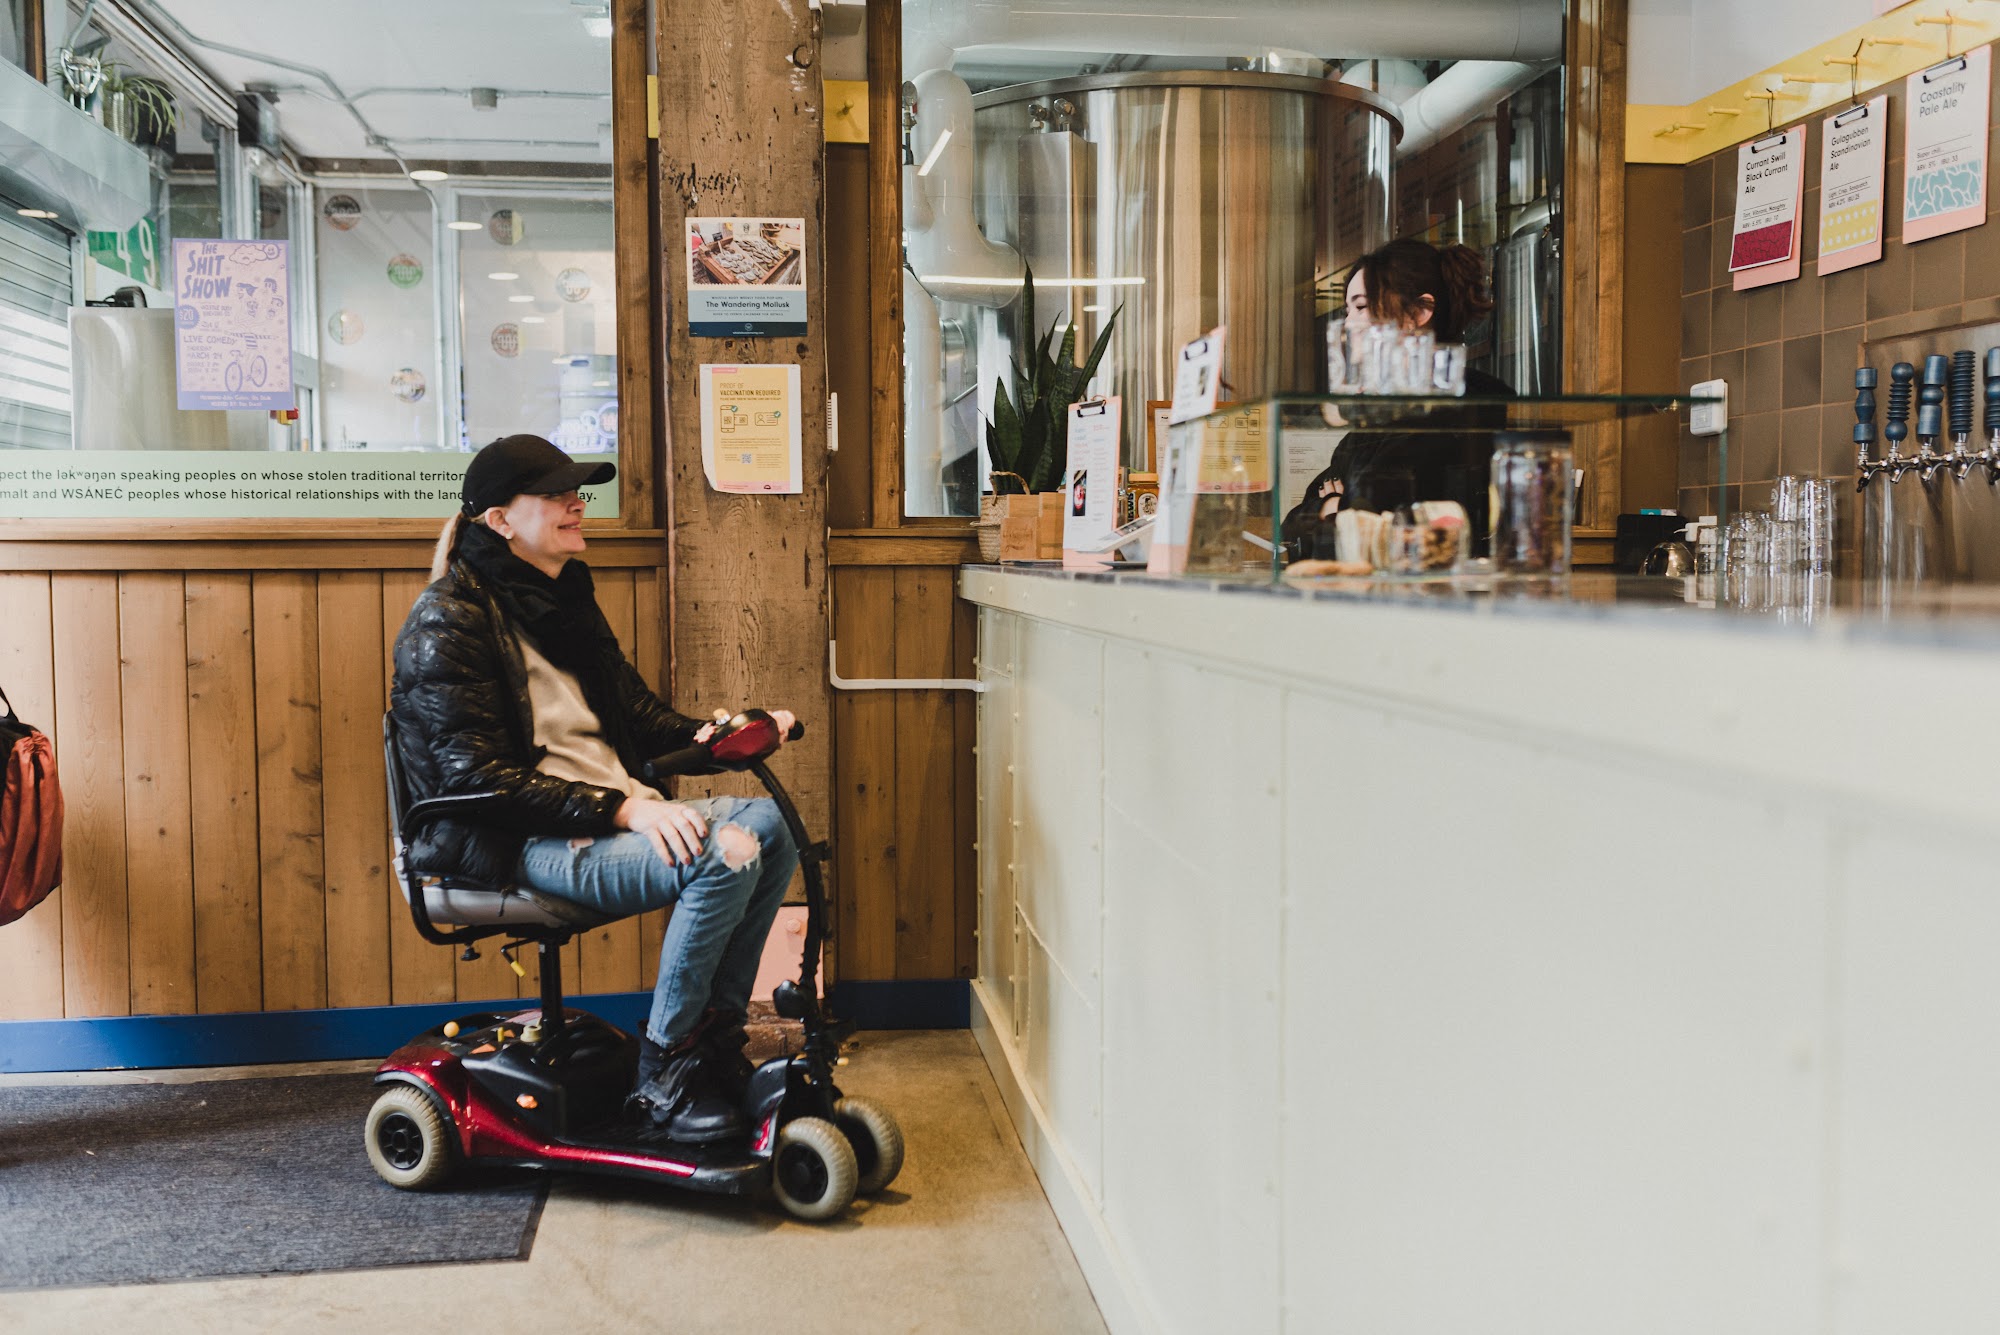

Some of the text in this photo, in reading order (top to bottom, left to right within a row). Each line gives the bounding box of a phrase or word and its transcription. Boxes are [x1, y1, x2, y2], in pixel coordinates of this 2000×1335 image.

[1920, 82, 1967, 104] Coastality
[1919, 98, 1958, 118] Pale Ale
[1830, 138, 1871, 159] Scandinavian
[1746, 151, 1786, 171] Currant Swill
[1830, 162, 1840, 171] Ale
[1745, 163, 1788, 183] Black Currant
[1745, 185, 1756, 194] Ale
[202, 242, 218, 255] THE
[187, 249, 226, 276] SHIT
[181, 275, 232, 299] SHOW
[720, 301, 761, 309] Wandering
[183, 335, 238, 346] LIVE COMEDY
[0, 470, 28, 482] pect
[32, 470, 52, 480] the
[121, 469, 181, 483] speaking
[185, 470, 236, 483] peoples
[241, 472, 257, 480] on
[261, 470, 303, 480] whose
[308, 470, 347, 480] stolen
[351, 470, 416, 481] traditional
[420, 471, 466, 481] territor
[0, 488, 28, 499] malt
[33, 489, 57, 499] and
[128, 489, 180, 502] peoples
[184, 489, 227, 499] whose
[231, 489, 292, 499] historical
[296, 489, 379, 502] relationships
[383, 489, 410, 500] with
[414, 489, 434, 500] the
[579, 492, 597, 503] ay.
